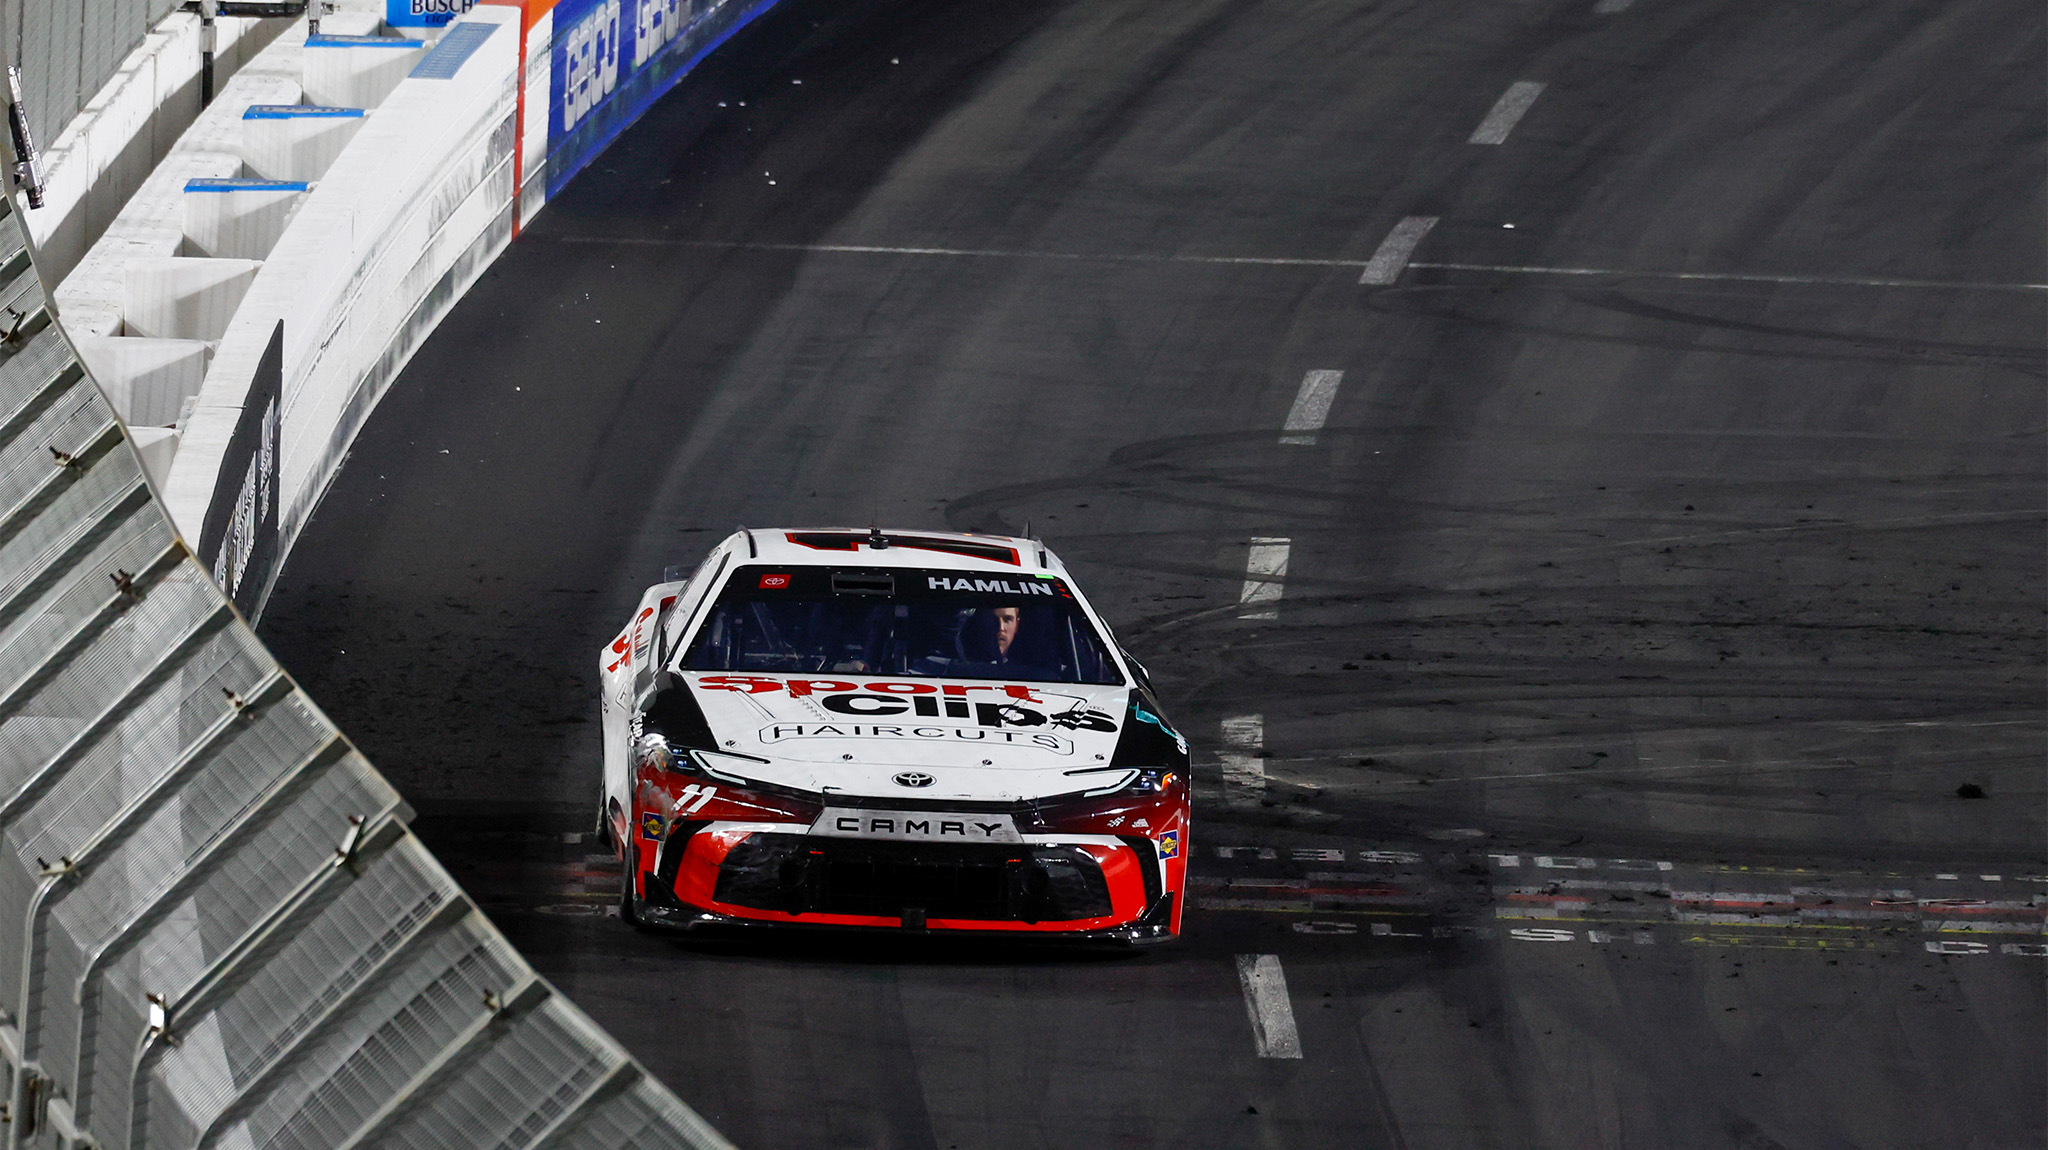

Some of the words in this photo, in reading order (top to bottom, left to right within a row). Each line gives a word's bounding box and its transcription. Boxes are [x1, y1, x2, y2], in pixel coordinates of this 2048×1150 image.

[564, 0, 621, 132] GEICO
[927, 576, 1053, 596] HAMLIN
[698, 676, 1044, 704] Sport
[773, 725, 1060, 749] HAIRCUTS
[671, 783, 718, 813] 11
[836, 807, 1003, 836] CAMRY
